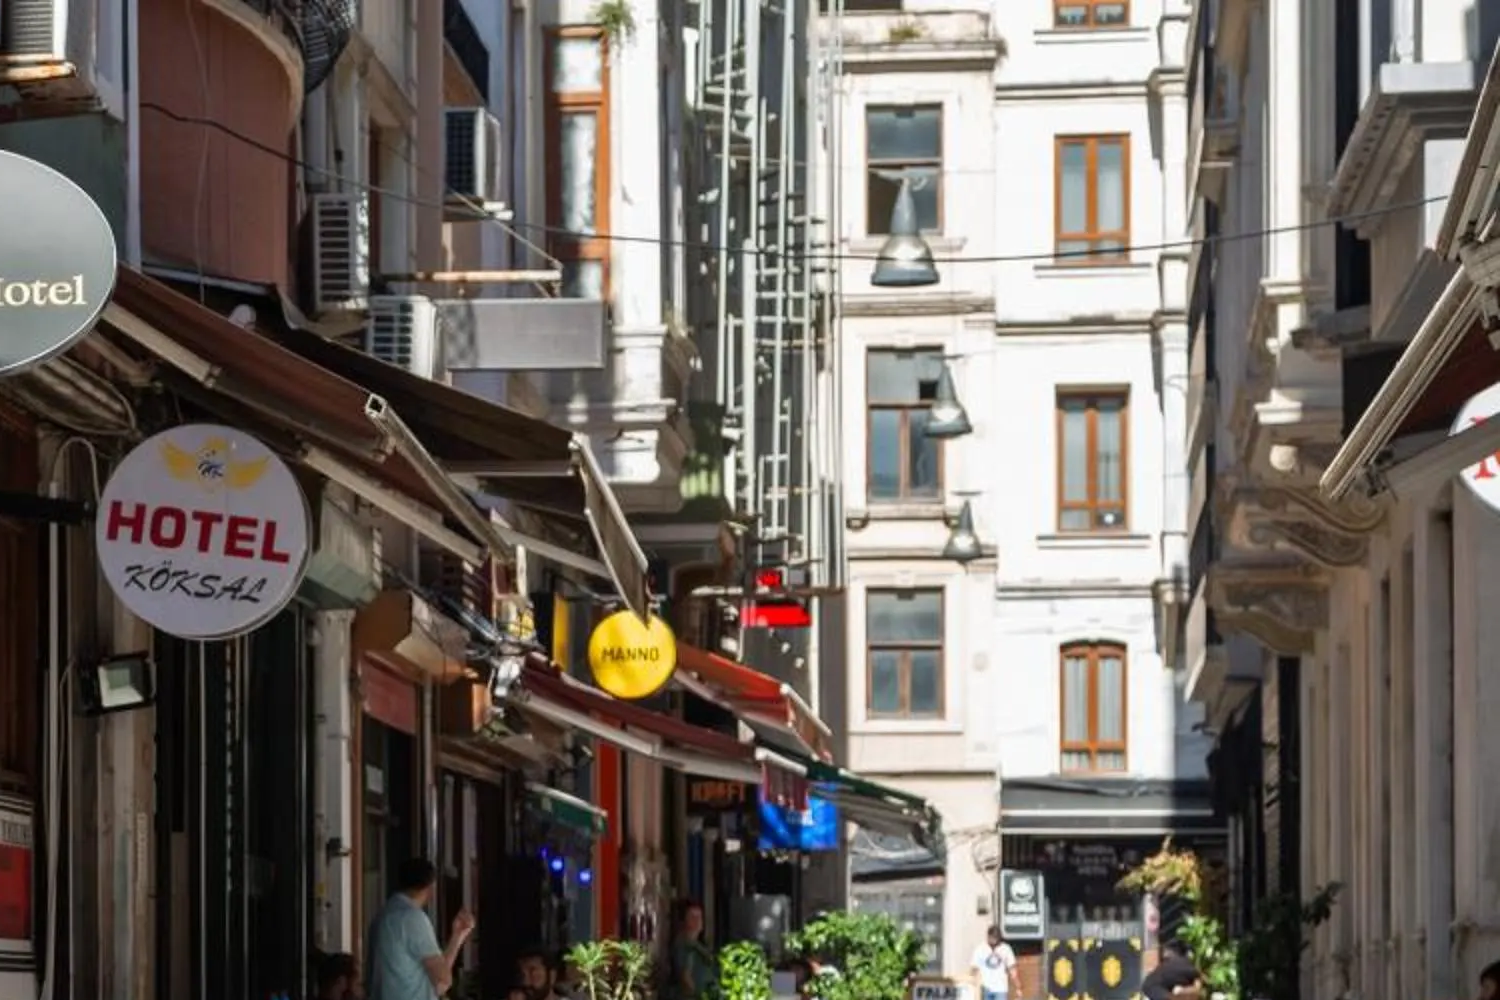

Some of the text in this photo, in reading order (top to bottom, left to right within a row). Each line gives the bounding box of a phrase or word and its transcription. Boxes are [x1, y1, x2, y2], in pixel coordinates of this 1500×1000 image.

[106, 500, 290, 564] HOTEL
[124, 560, 269, 603] KÖKSAL
[601, 646, 660, 662] MANNO
